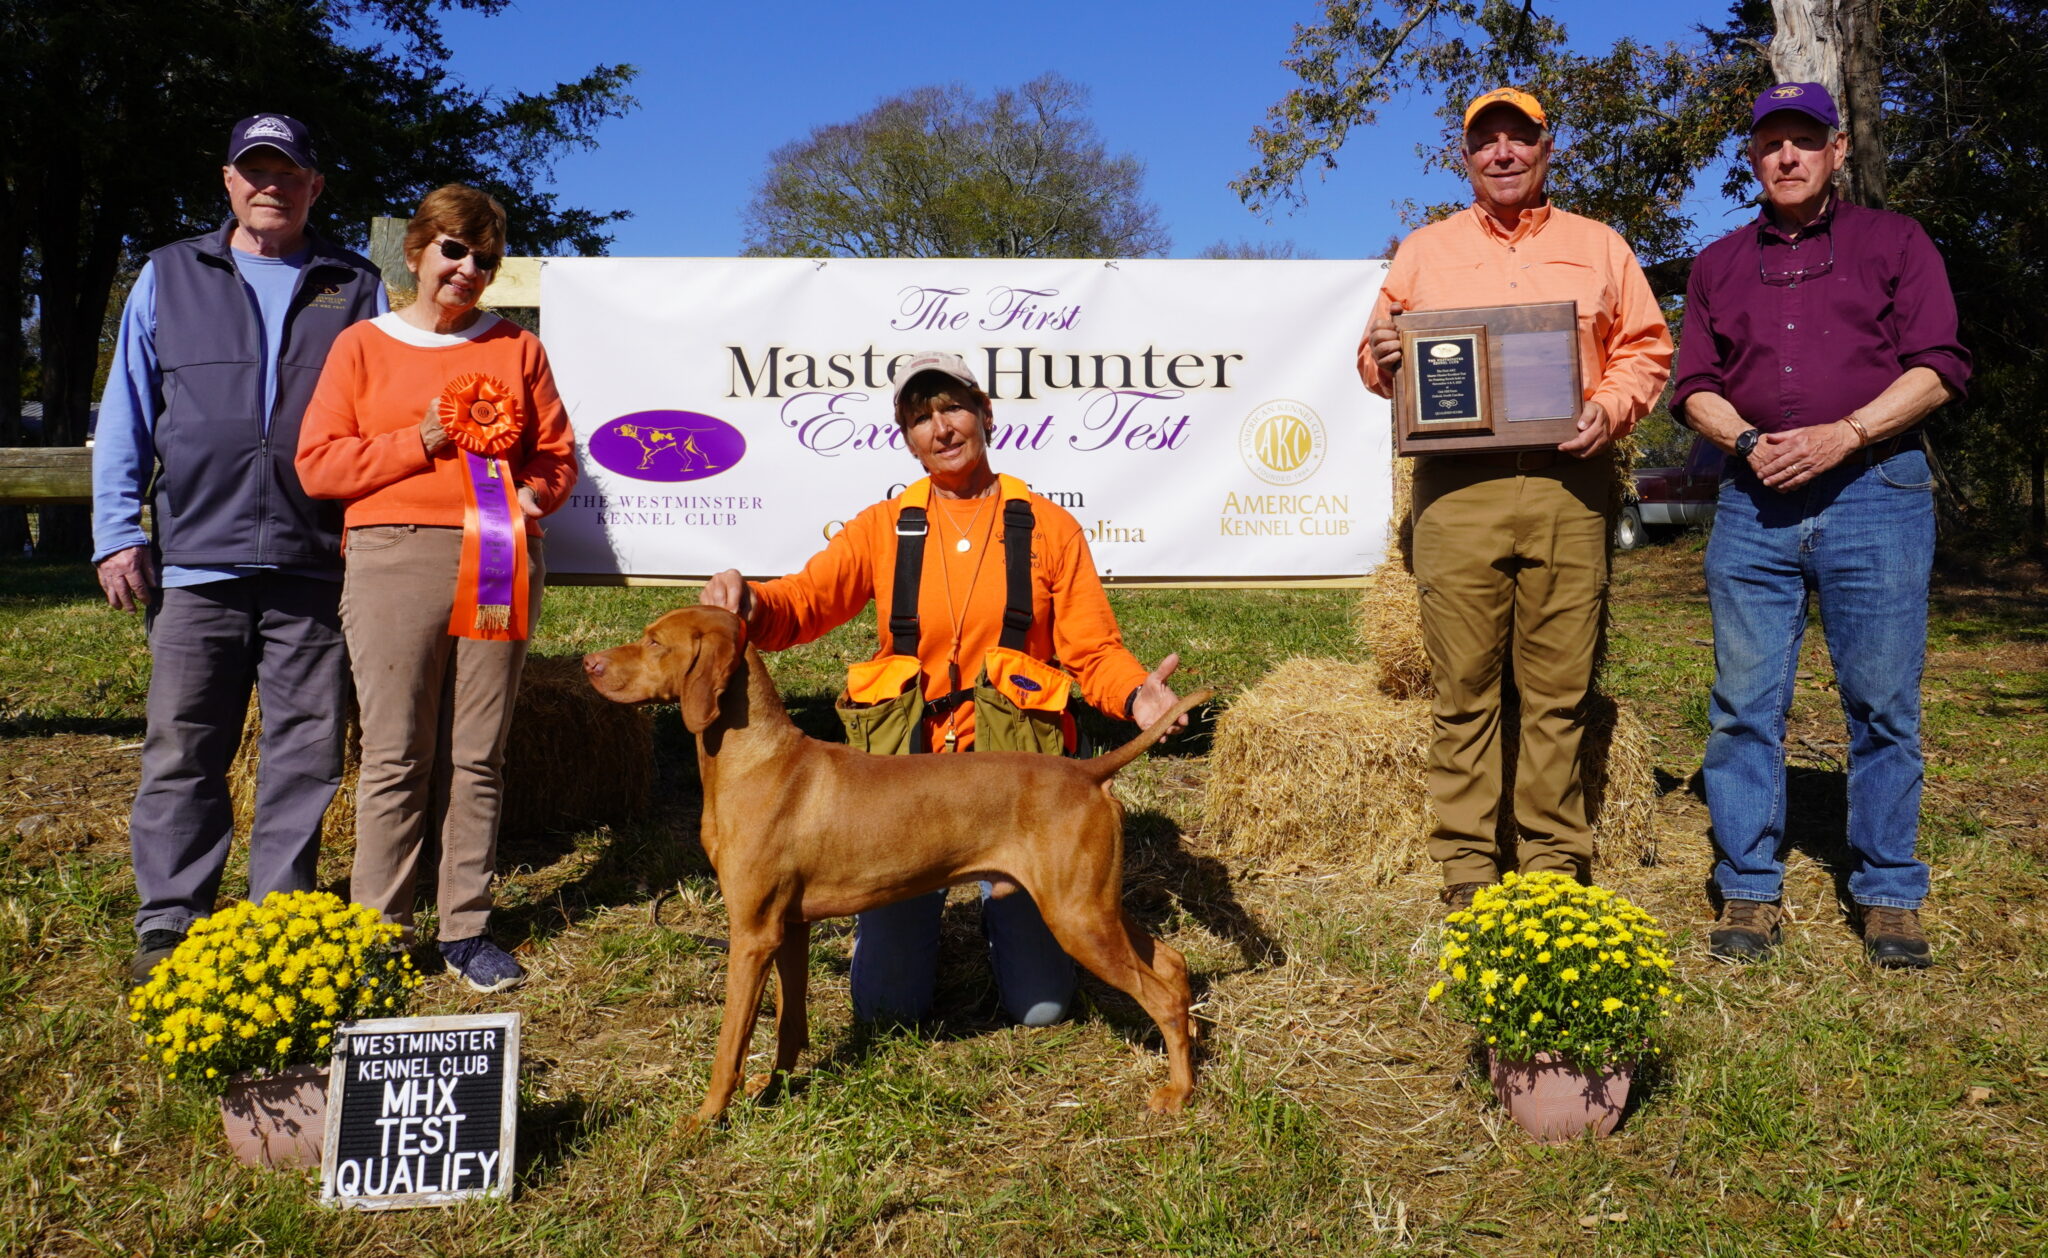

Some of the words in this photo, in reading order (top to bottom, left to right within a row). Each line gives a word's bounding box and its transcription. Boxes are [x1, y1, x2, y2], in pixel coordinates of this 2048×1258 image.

[890, 286, 970, 331] The
[979, 286, 1082, 331] First
[725, 345, 963, 398] Maste
[981, 345, 1244, 399] Hunter
[1069, 387, 1191, 451] Test
[1258, 417, 1309, 470] AKC
[570, 495, 609, 508] THE
[619, 495, 764, 509] WESTMINSTER
[597, 512, 675, 525] KENNEL
[685, 512, 737, 526] CLUB
[1221, 491, 1349, 514] AMERICAN
[1083, 520, 1146, 542] olina
[1220, 517, 1294, 536] KENNEL
[353, 1030, 496, 1056] WESTMINSTER
[358, 1058, 435, 1082] KENNEL
[440, 1055, 489, 1076] CLUB
[382, 1077, 458, 1118] MHX
[375, 1114, 466, 1157] TEST
[336, 1150, 499, 1197] QUALIFY
